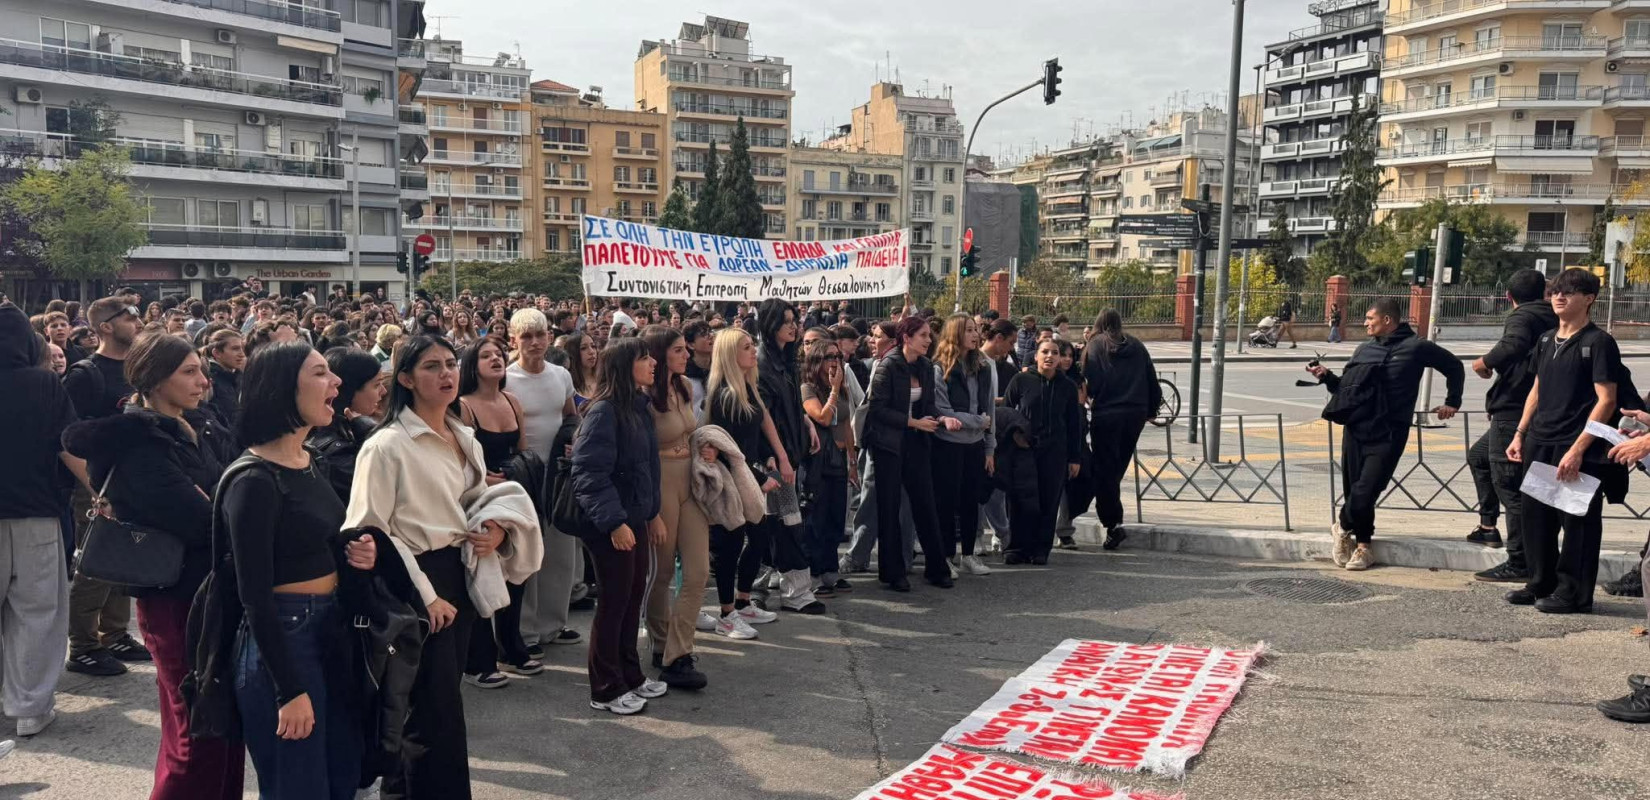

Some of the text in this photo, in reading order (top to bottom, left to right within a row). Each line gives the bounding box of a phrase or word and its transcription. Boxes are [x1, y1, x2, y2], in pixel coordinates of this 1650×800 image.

[584, 242, 682, 269] ΠΑΛΕΥΟΥΜΕ
[684, 253, 711, 269] ΓΙΑ
[719, 257, 773, 273] ΔΩΡΕΑΝ
[785, 252, 849, 272] ΔΗΜΟΣΙΑ
[585, 217, 612, 239] ΣΕ
[616, 221, 650, 245] ΟΛΗ
[657, 228, 695, 250] ΤΗΝ
[700, 234, 763, 258] ΕΥΡΩΠΗ
[772, 241, 827, 260] ΕΛΛΑΔΑ
[856, 231, 901, 248] ΓΑΛΛΙΑ
[256, 269, 331, 278] The Urban Garden
[607, 271, 885, 300] Συντονιστική Επιτροπή Μαθητών Θεσσαλονίκης
[1047, 641, 1118, 687] ΑΝΑΓΚΗ
[1140, 645, 1211, 693] ΓΙΝΕΤΑΙ
[1019, 704, 1111, 760] ΓΙΝΕΤΑΙ
[1080, 693, 1181, 768] ΚΑΝΟΝΑΣ
